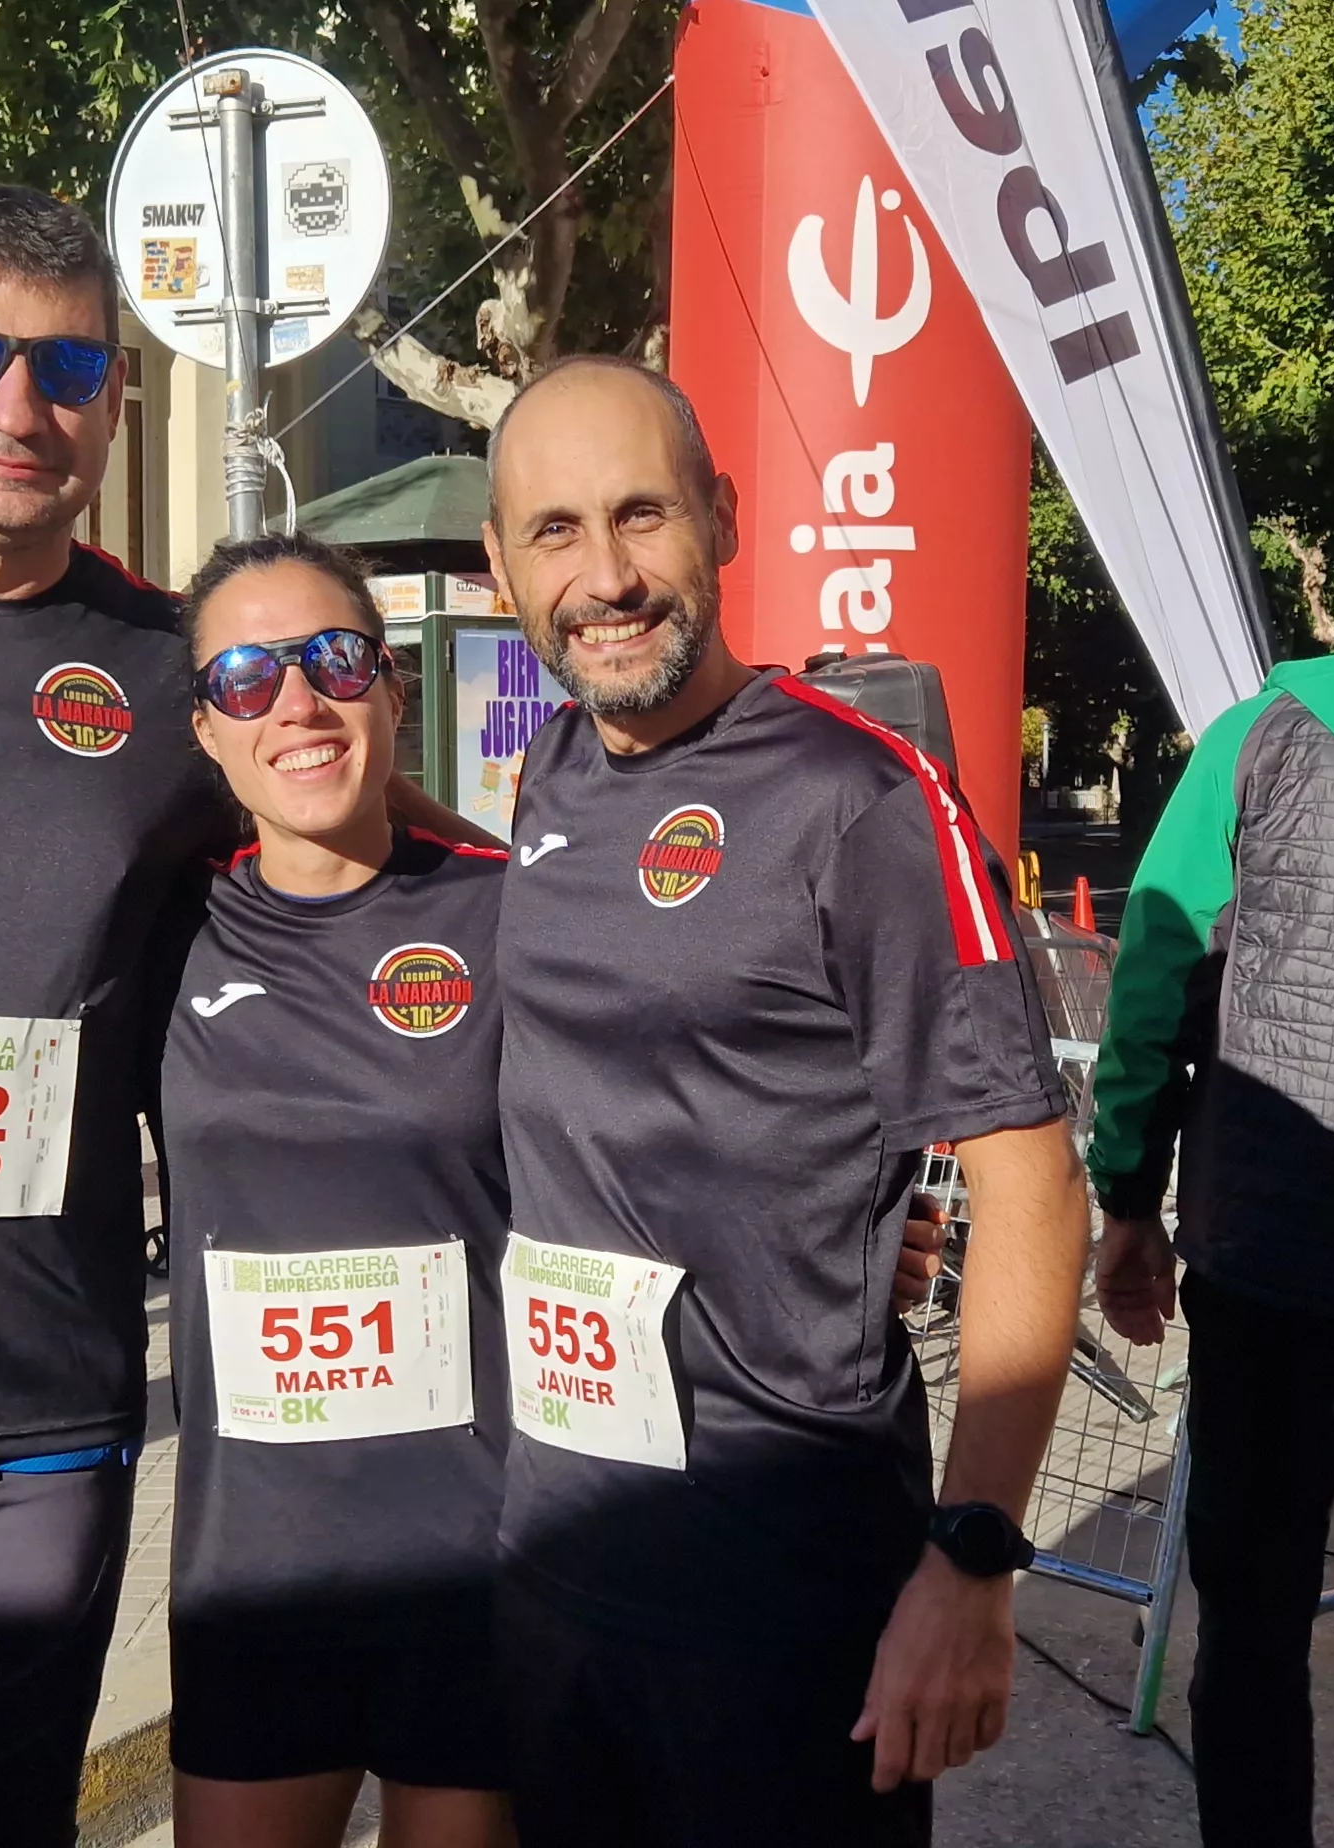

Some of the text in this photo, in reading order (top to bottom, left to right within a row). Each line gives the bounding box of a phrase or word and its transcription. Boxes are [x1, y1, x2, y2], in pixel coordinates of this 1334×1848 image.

[897, 0, 1141, 386] Ibe
[142, 203, 205, 228] SMAK47
[790, 442, 916, 653] aja
[498, 639, 539, 697] BIEN
[33, 694, 133, 733] LA MARATÓN
[73, 724, 95, 746] 10
[638, 842, 724, 876] LA MARATÓN
[368, 977, 473, 1005] LA MARATÓN
[410, 1005, 433, 1027] 10
[264, 1254, 399, 1277] III CARRERA
[527, 1247, 616, 1280] III CARRERA
[265, 1270, 400, 1293] EMPRESAS HUESCA
[528, 1265, 612, 1299] EMPRESAS HUESCA
[260, 1300, 395, 1362] 551
[528, 1296, 617, 1372] 553
[275, 1364, 395, 1394] MARTA
[536, 1367, 616, 1407] JAVIER
[281, 1396, 329, 1425] 8K
[541, 1396, 572, 1430] 8K
